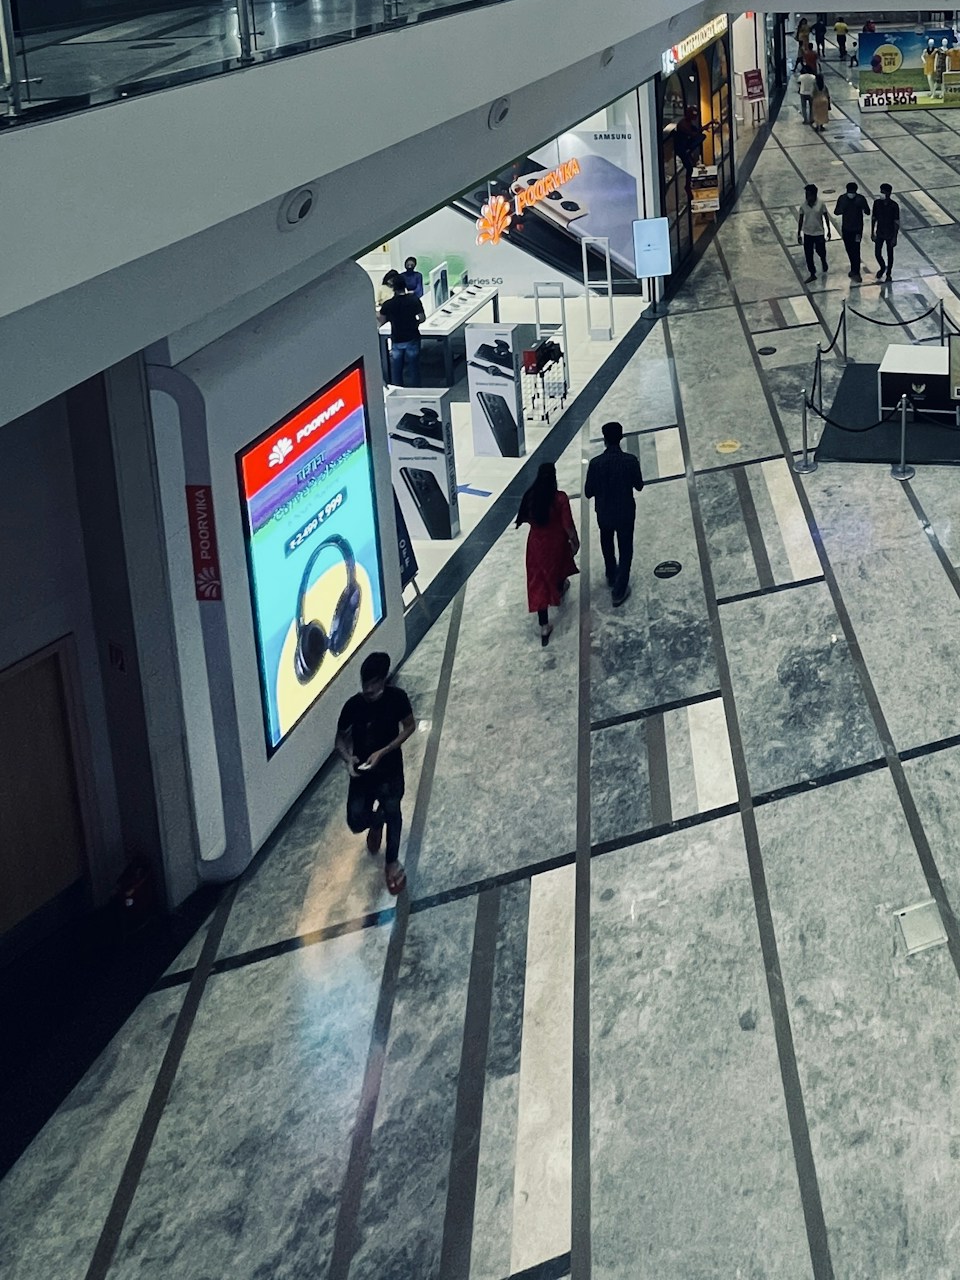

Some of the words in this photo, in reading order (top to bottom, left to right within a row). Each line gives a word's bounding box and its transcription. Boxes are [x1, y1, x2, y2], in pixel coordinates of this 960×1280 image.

[864, 95, 917, 107] BLOSSOM
[593, 133, 632, 141] SAMSUNG
[515, 158, 580, 216] POORVIKA
[467, 277, 490, 285] eries
[491, 277, 503, 285] 5G
[297, 398, 345, 444] POORVIKA
[195, 489, 212, 560] POORVIKA
